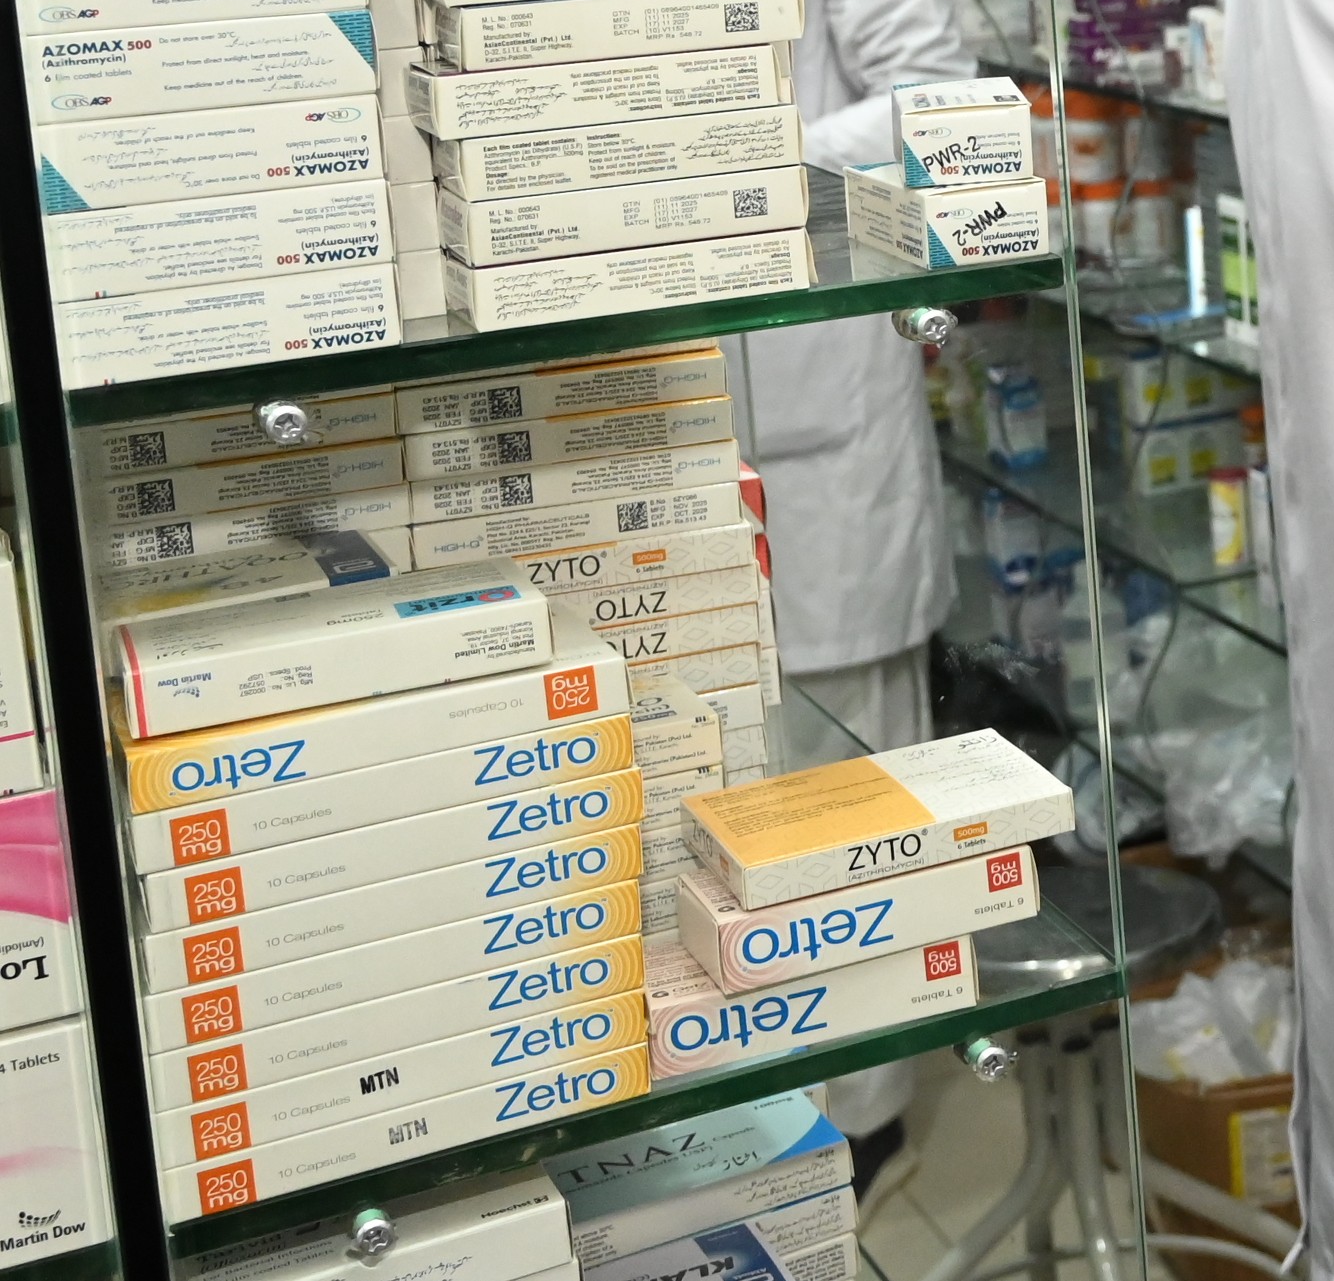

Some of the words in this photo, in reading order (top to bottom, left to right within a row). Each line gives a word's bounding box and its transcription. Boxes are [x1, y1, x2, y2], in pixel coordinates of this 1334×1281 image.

[42, 40, 123, 58] AZOMAX
[127, 39, 152, 50] 500
[41, 53, 127, 69] (Azithromycin)
[962, 245, 980, 256] 500
[982, 239, 1039, 255] AZOMAX
[284, 339, 309, 350] 500
[312, 330, 386, 348] AZOMAX
[528, 555, 600, 585] ZYTO
[596, 591, 666, 620] ZYTO
[552, 675, 587, 693] mg
[553, 688, 589, 710] 250
[172, 741, 306, 792] Zetro
[253, 819, 267, 831] 10
[270, 807, 332, 829] Capsules
[487, 790, 609, 841] Zetro
[957, 826, 985, 838] 500mg
[848, 834, 922, 871] ZYTO
[990, 859, 1016, 874] mg
[193, 878, 236, 899] 250
[992, 871, 1018, 885] 500
[197, 895, 236, 915] mg
[975, 901, 1014, 915] Tablets
[484, 900, 605, 955] Zetro
[488, 956, 609, 1011] Zetro
[190, 996, 233, 1017] 250
[194, 1014, 233, 1035] mg
[670, 987, 827, 1051] Zetro
[10, 1050, 61, 1072] Tablets
[360, 1068, 400, 1095] MTN
[495, 1067, 616, 1123] Zetro
[389, 1118, 429, 1145] MTN
[0, 1229, 51, 1252] Martin
[54, 1222, 86, 1241] Dow
